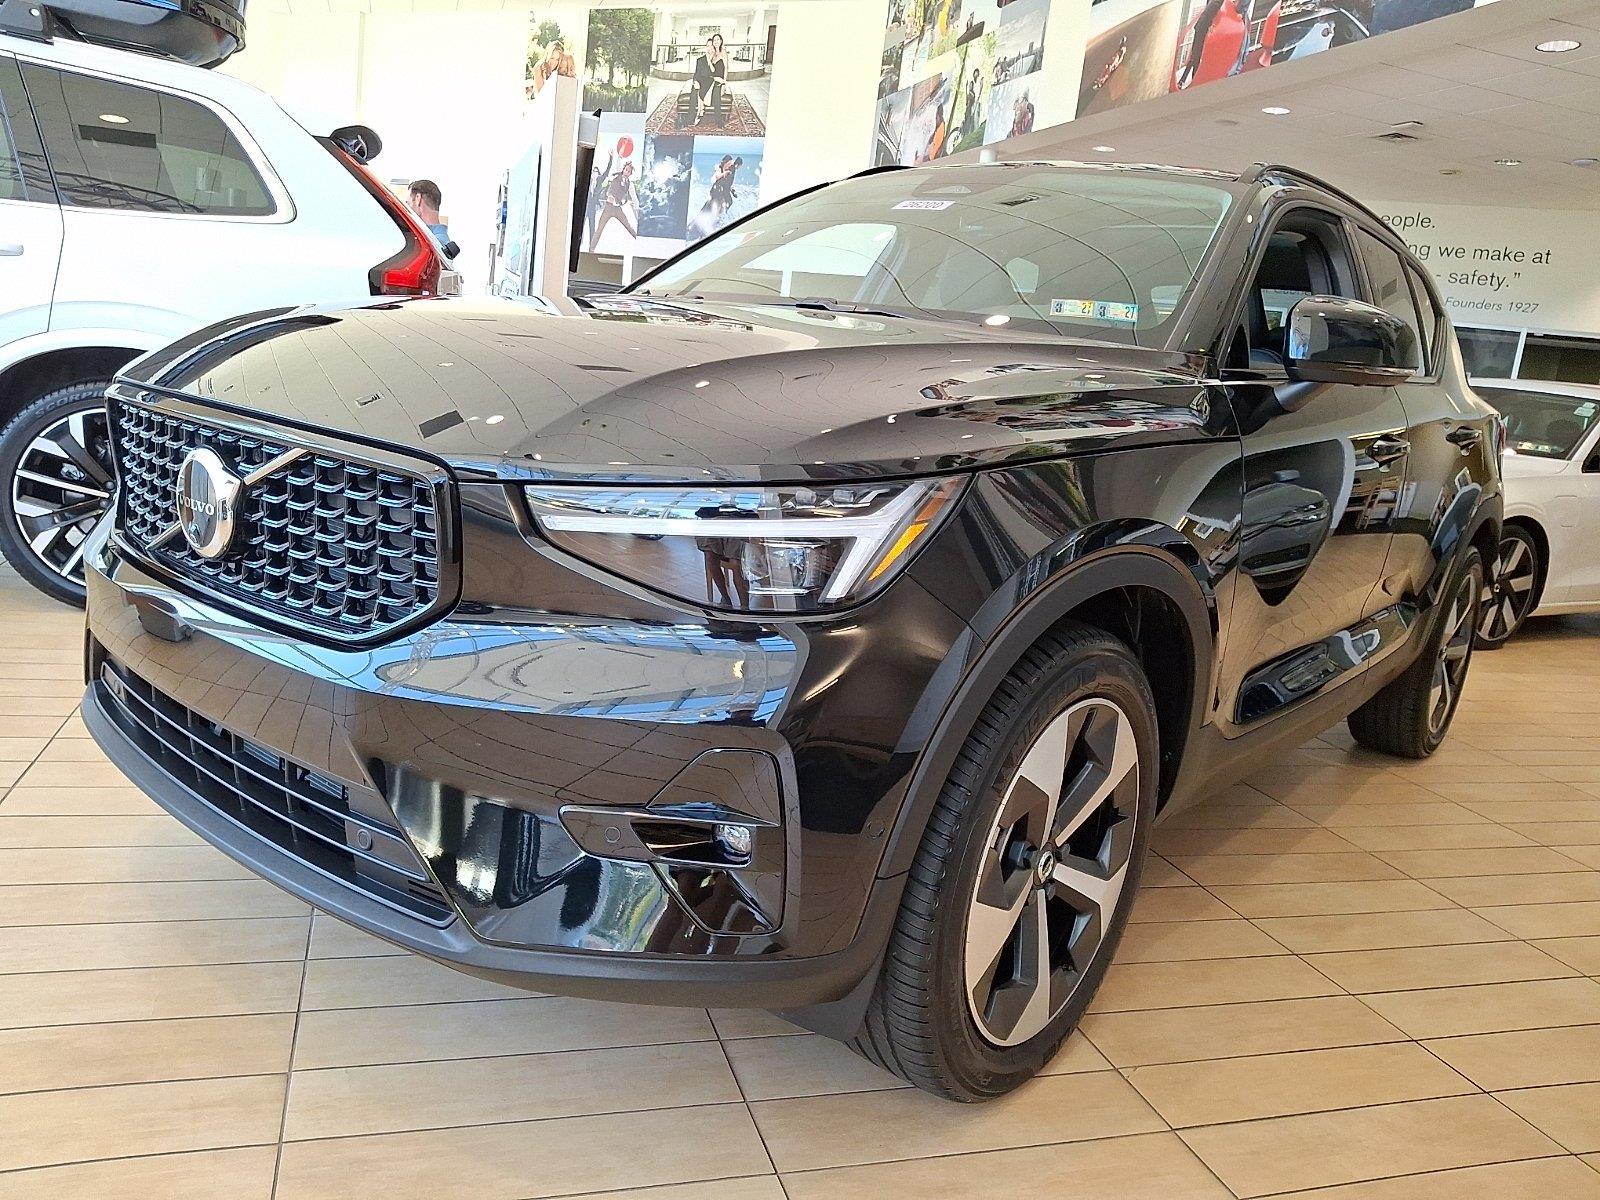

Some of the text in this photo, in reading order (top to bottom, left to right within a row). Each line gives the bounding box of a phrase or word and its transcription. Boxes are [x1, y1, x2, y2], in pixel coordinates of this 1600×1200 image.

[1381, 211, 1435, 231] eople.
[1438, 246, 1466, 259] we
[1472, 246, 1525, 263] make
[1531, 249, 1552, 265] at
[1054, 302, 1063, 313] 3
[1081, 302, 1092, 315] 27
[1098, 305, 1106, 317] 3
[1124, 305, 1135, 319] 27
[1444, 296, 1540, 314] Founders 1927
[178, 493, 215, 516] VOLVO
